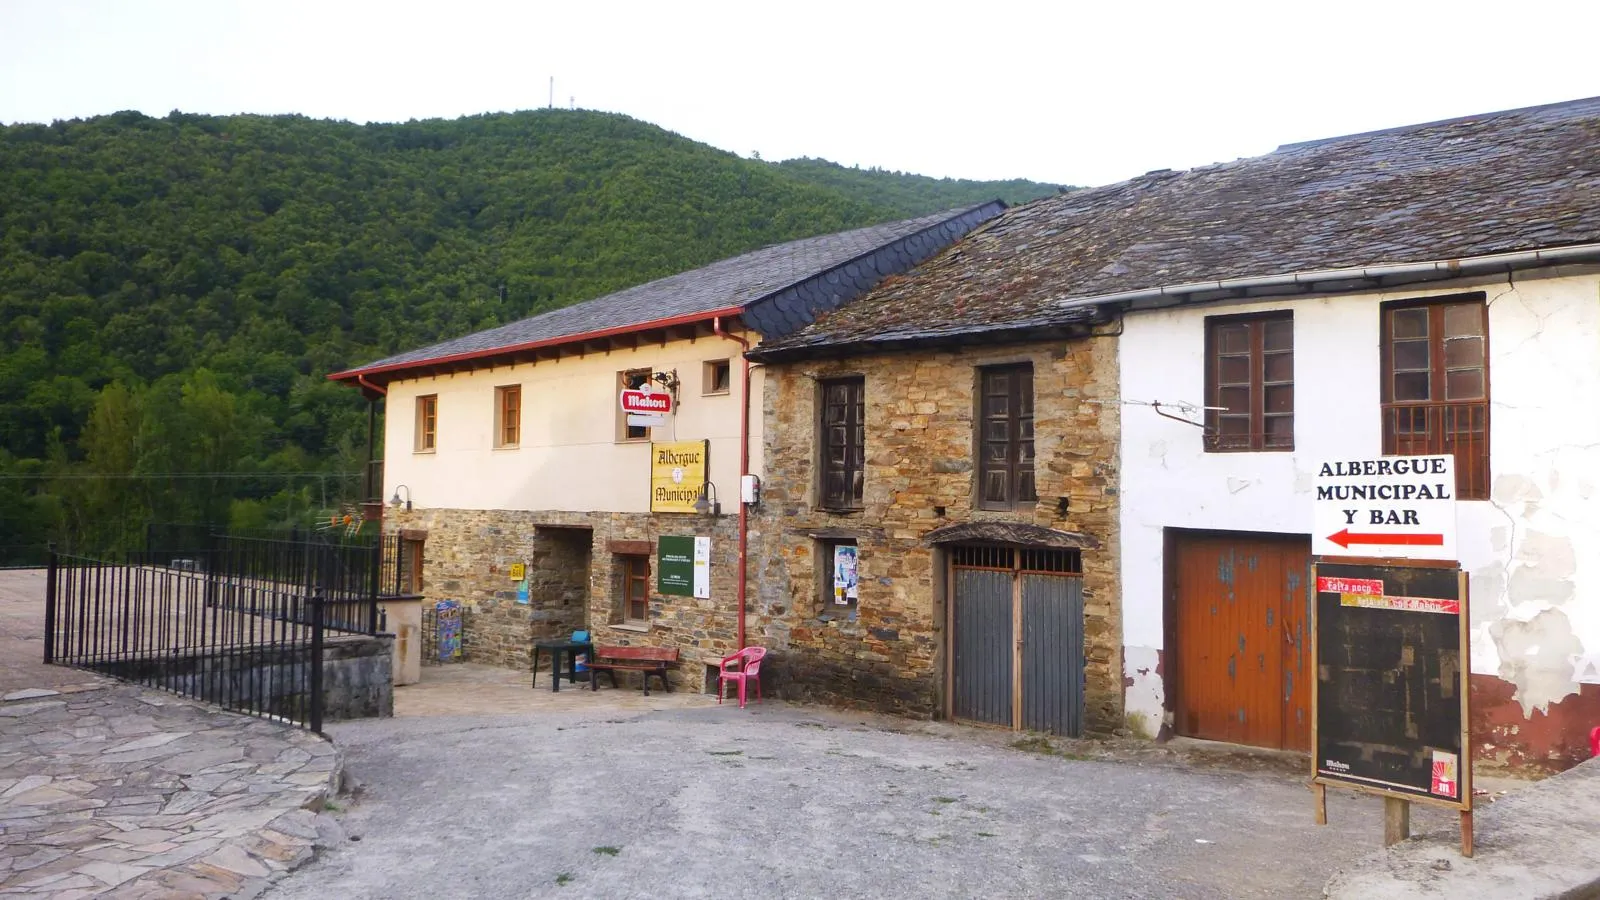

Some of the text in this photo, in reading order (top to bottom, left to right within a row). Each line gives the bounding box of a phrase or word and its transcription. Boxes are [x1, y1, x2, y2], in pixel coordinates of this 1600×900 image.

[627, 395, 666, 408] Mahou
[658, 449, 700, 467] Albergue
[1318, 458, 1447, 477] ALBERGUE
[655, 485, 703, 504] Municipal
[1316, 484, 1451, 500] MUNICIPAL
[1342, 509, 1420, 525] Y BAR
[1327, 581, 1349, 591] Falta
[1326, 760, 1350, 770] Mahou
